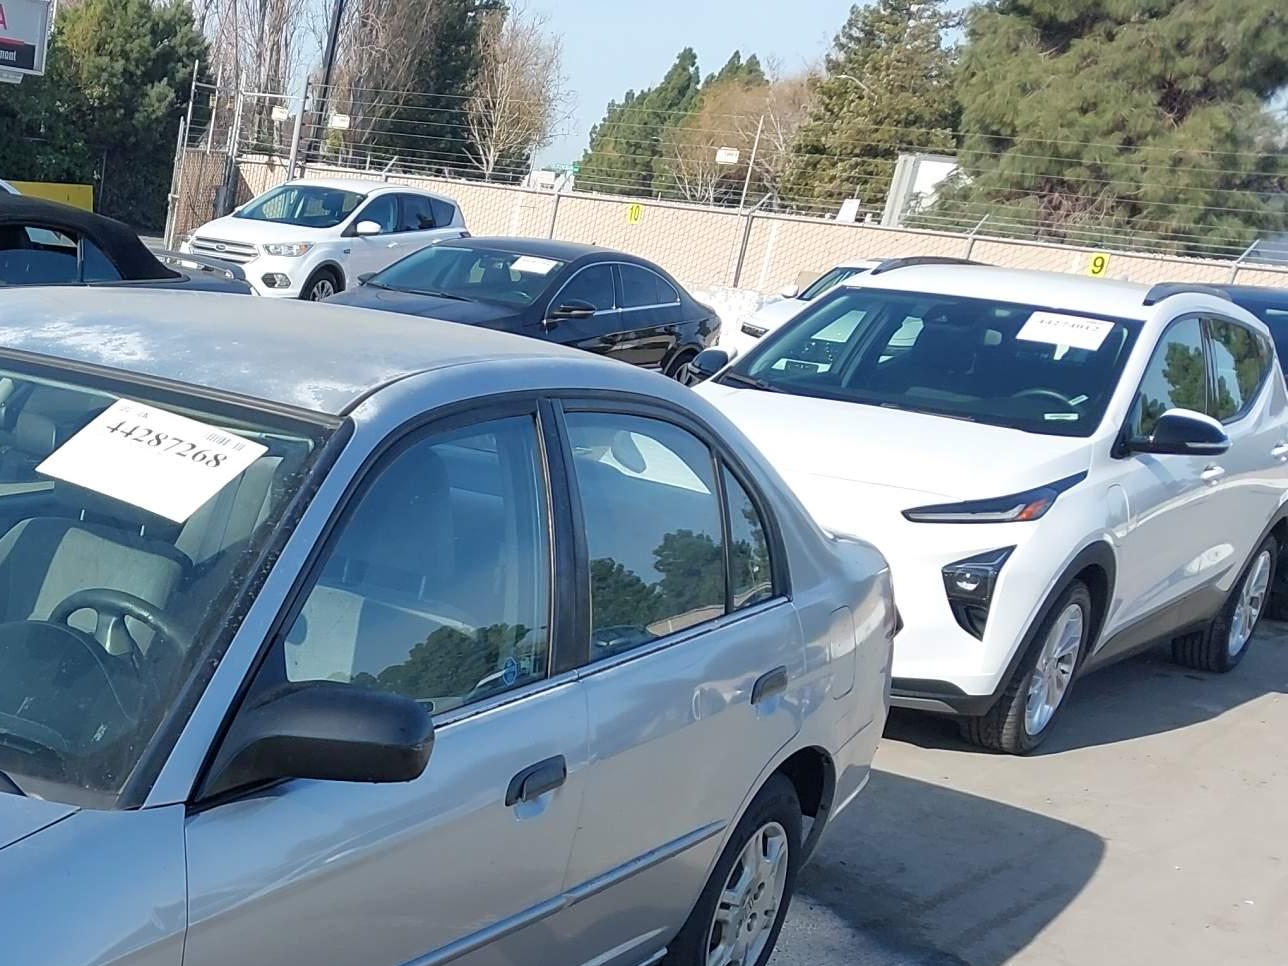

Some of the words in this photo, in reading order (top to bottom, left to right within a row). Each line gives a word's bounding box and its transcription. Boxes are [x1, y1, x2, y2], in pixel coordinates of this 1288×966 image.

[630, 205, 640, 221] 10
[1091, 256, 1105, 275] 9
[106, 420, 228, 468] 44287268
